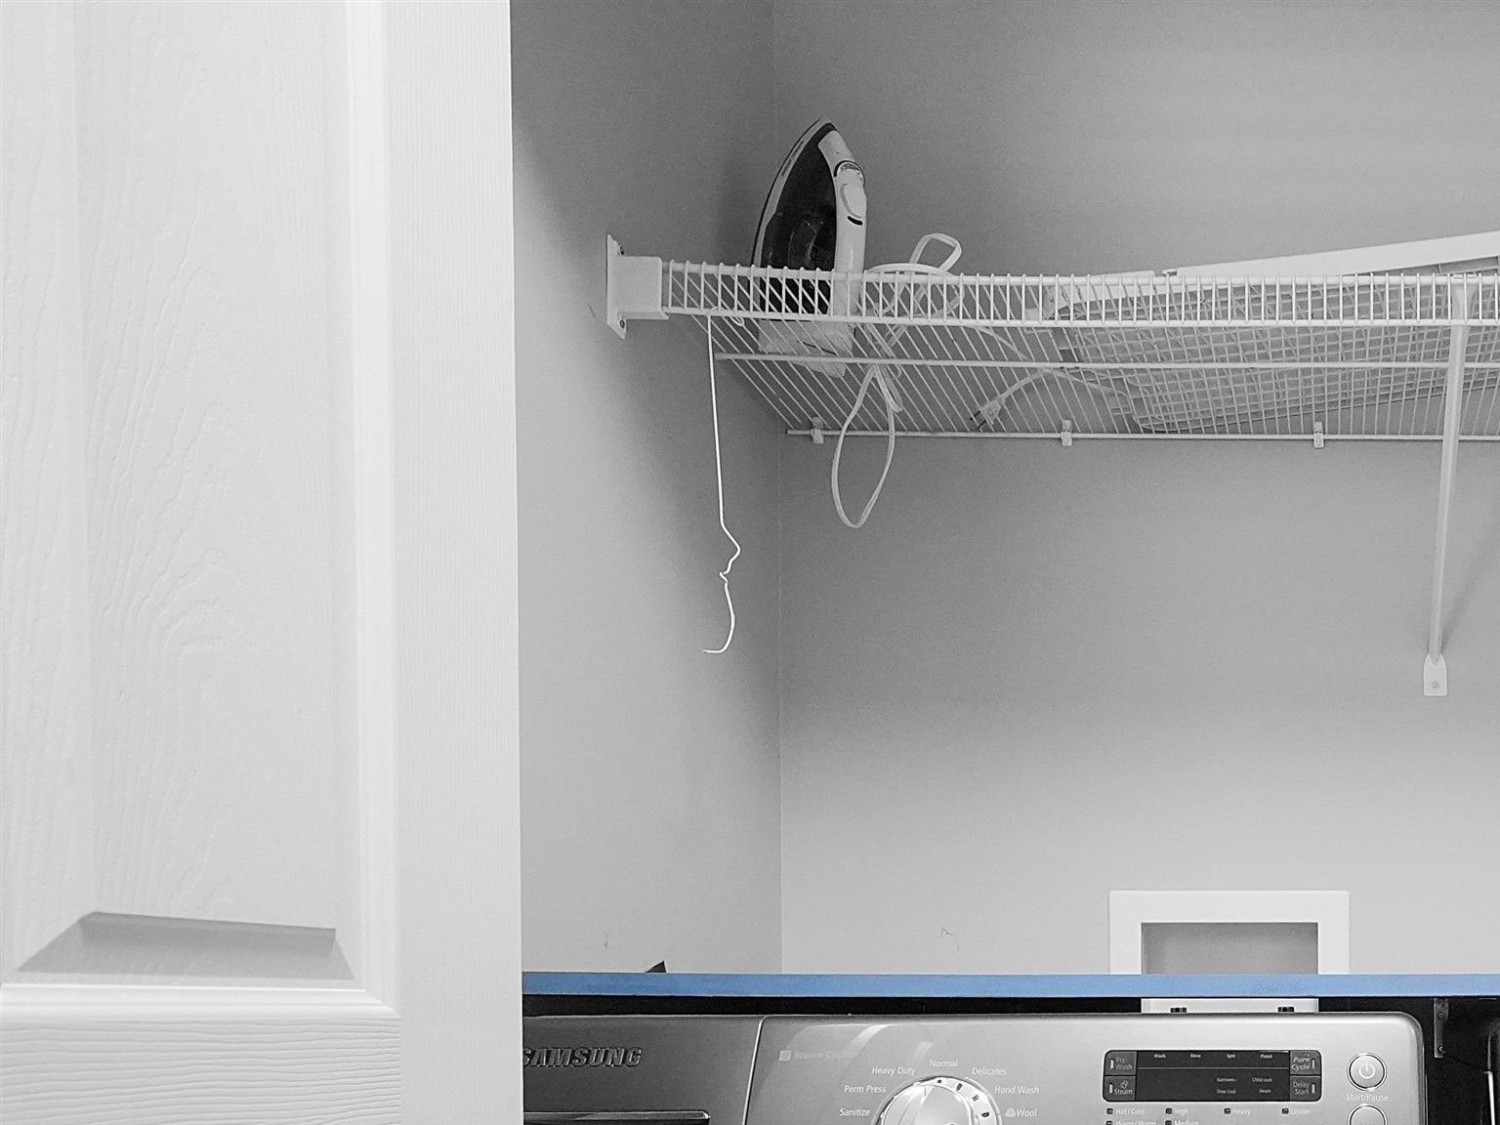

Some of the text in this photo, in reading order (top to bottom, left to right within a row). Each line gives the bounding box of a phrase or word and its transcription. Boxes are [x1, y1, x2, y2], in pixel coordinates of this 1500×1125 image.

[929, 1059, 959, 1068] Normal
[871, 1066, 917, 1077] Heavy Duty
[971, 1067, 1008, 1076] Delicates
[843, 1084, 888, 1093] Perm Press
[994, 1085, 1040, 1094] Hand Wash
[1113, 1088, 1133, 1096] Steam
[839, 1107, 872, 1117] Sanitize
[1016, 1108, 1039, 1118] Wool
[1174, 1108, 1189, 1117] High
